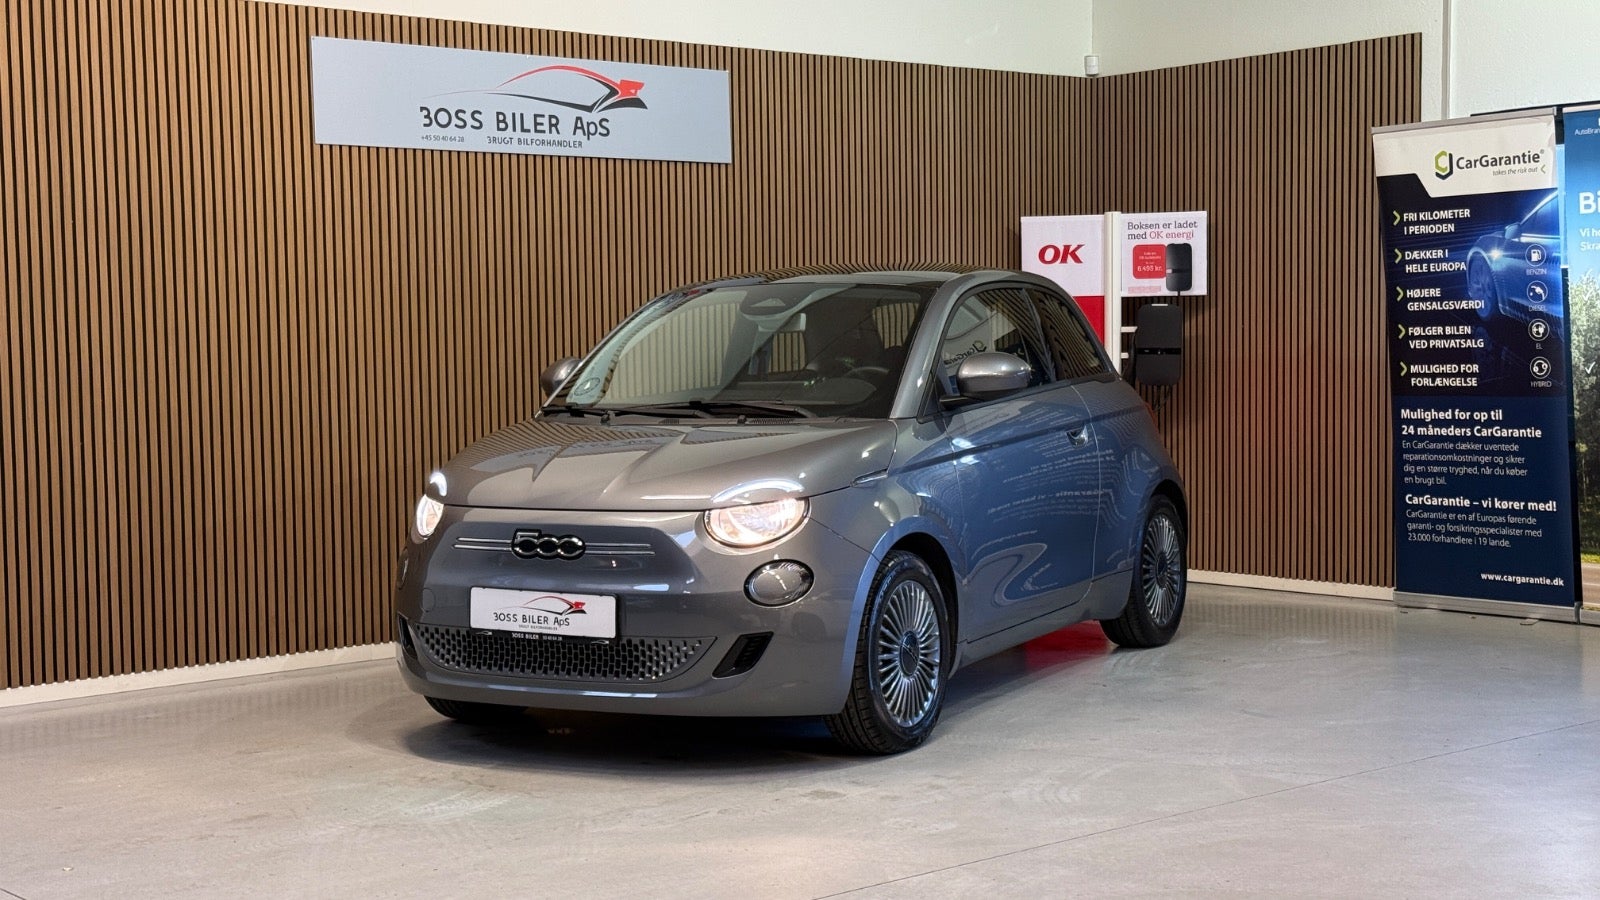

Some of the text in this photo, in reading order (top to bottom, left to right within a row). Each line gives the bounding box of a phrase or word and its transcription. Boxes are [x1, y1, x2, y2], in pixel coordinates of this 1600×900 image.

[496, 111, 560, 135] BILER
[572, 116, 610, 141] ApS
[518, 138, 583, 148] BILFORHANDLER
[1403, 208, 1470, 222] FRI KILOMETER
[1127, 222, 1160, 230] Boksen
[1175, 220, 1198, 229] ladet
[1404, 223, 1455, 235] I PERIODEN
[1128, 230, 1194, 240] med OK energi
[1580, 228, 1589, 237] Vi
[1038, 244, 1085, 264] OK
[1405, 249, 1448, 260] DÆKKER I
[1406, 262, 1467, 273] HELE EUROPA
[1526, 268, 1547, 276] BENZIN
[1406, 288, 1441, 298] HØJERE
[1407, 300, 1484, 311] GENSALGSVÆRDI
[1529, 304, 1547, 312] DIESEL
[1408, 326, 1471, 336] FØLGER BILEN
[1409, 339, 1484, 348] VED PRIVATSALG
[1410, 364, 1479, 374] MULIGHED FOR
[1411, 378, 1478, 387] FORLÆNGELSE
[1401, 409, 1502, 423] Mulighed for op til
[1402, 424, 1542, 438] 24 måneders CarGarantie
[1402, 440, 1519, 451] En CarGarantie dækker uventede
[1403, 453, 1525, 465] reparationsomkostninger og sikrer
[1404, 464, 1415, 474] dig
[1449, 466, 1479, 475] tryghed,
[1481, 466, 1493, 475] når
[1494, 467, 1504, 475] du
[1506, 467, 1528, 476] køber
[1404, 475, 1447, 486] en brugt bil.
[1406, 494, 1470, 507] CarGarantie
[1482, 498, 1492, 508] vi
[1495, 498, 1525, 510] kører
[1528, 500, 1557, 512] med!
[1406, 509, 1447, 520] CarGarantie
[1468, 512, 1476, 521] af
[1477, 513, 1506, 524] Europas
[1507, 514, 1536, 524] førende
[1407, 522, 1542, 537] garanti- og forsikringsspecialister med
[511, 528, 586, 560] 500
[1408, 532, 1430, 542] 23.000
[1432, 534, 1472, 544] forhandlere
[1478, 537, 1487, 545] 19
[1489, 538, 1511, 548] lande.
[1481, 573, 1564, 586] www.cargarantie.dk
[522, 614, 549, 624] BILER
[553, 616, 570, 628] ApS
